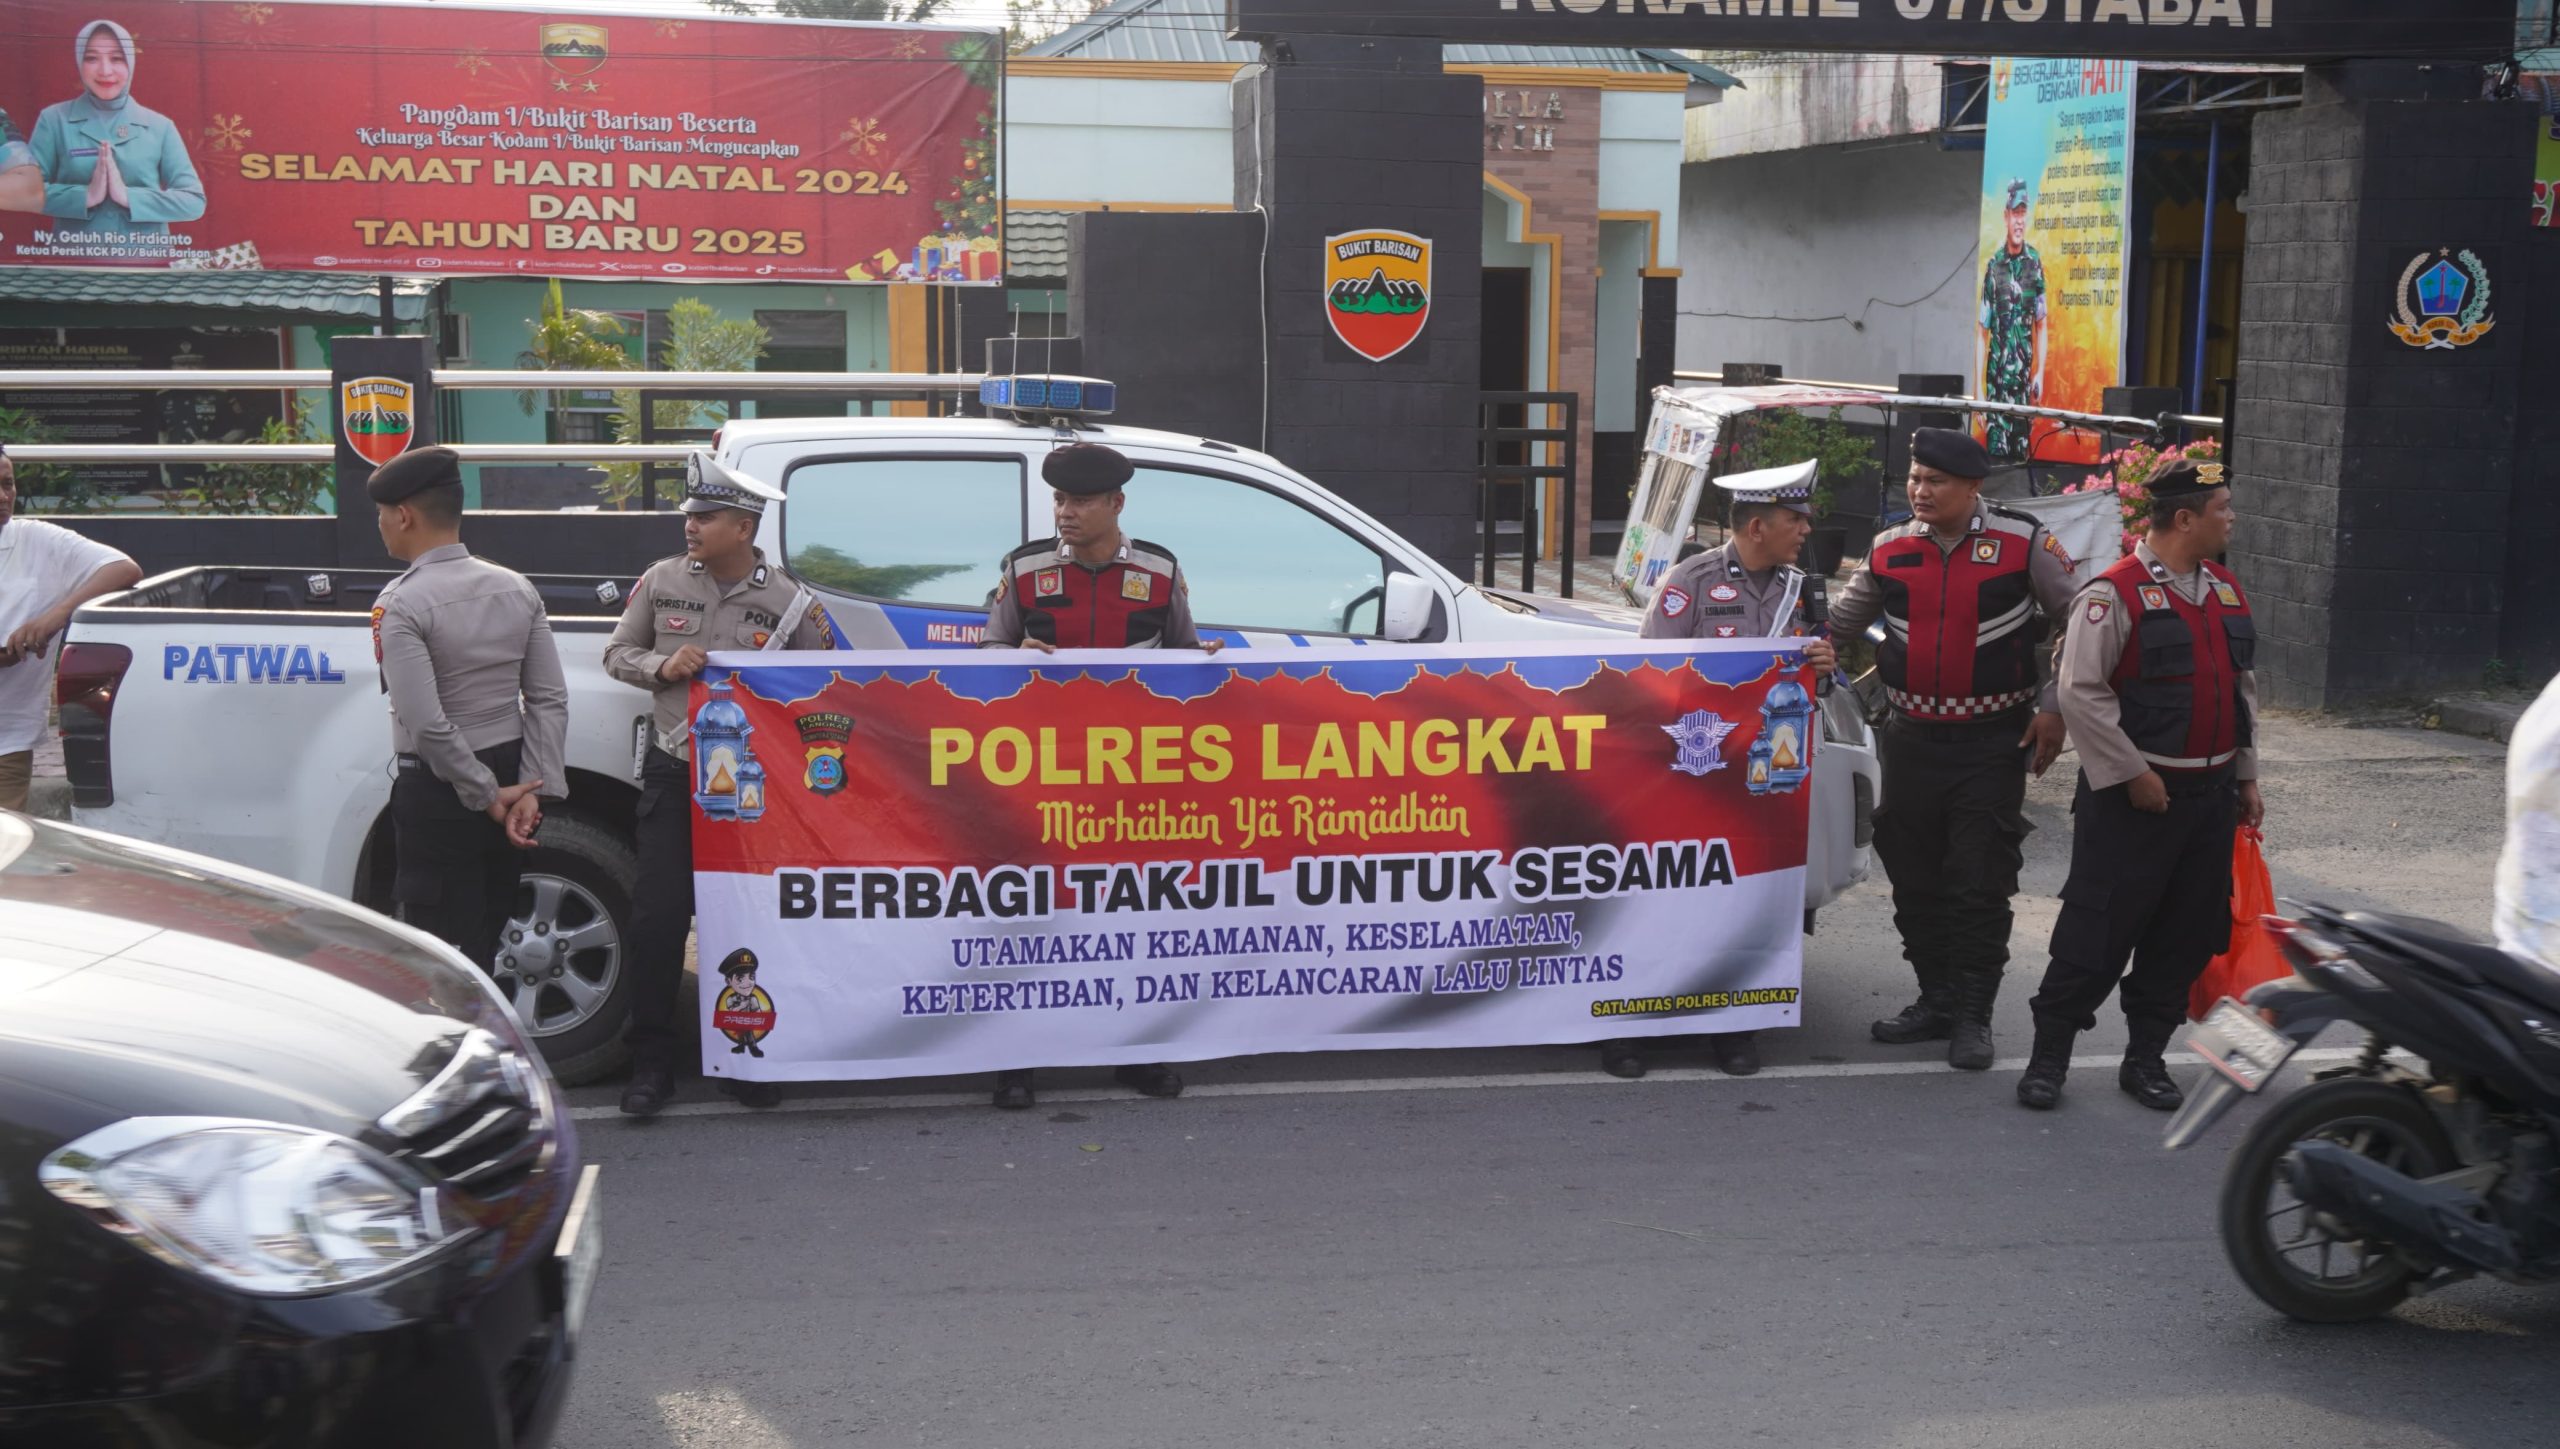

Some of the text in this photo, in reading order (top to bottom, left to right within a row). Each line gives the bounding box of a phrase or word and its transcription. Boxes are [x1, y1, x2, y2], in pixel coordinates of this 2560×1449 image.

[2014, 60, 2080, 86] BEKERJALAH
[1484, 90, 1565, 119] LLA
[2037, 79, 2080, 103] DENGAN
[400, 103, 757, 134] Pangdam I/Bukit Barisan Beserta
[355, 127, 800, 159] Keluarga Besar Kodam I/Bukit Barisan Mengucapkan
[240, 153, 909, 195] SELAMAT HARI NATAL 2024
[529, 194, 636, 222] DAN
[16, 245, 50, 256] Ketua
[52, 246, 84, 256] Persit
[86, 246, 109, 257] KCK
[111, 247, 126, 257] PD
[169, 248, 210, 259] Barisan
[34, 230, 193, 246] Ny. Galuh Rio Firdianto
[354, 220, 805, 255] TAHUN BARU 2025
[1338, 240, 1420, 261] BUKIT BARISAN
[350, 384, 405, 399] BUKIT BARISAN
[744, 610, 781, 630] POLR
[164, 643, 345, 684] PATWAL
[800, 712, 850, 726] POLRES
[931, 715, 1607, 787] POLRES LANGKAT
[1036, 792, 1471, 850] Märhäbän Yä Rämädhän
[779, 843, 1734, 919] BERBAGI TAKJIL UNTUK SESAMA
[952, 913, 1583, 968] UTAMAKAN KEAMANAN, KESELAMATAN,
[903, 953, 1624, 1015] KETERTIBAN, DAN KELANCARAN LALU LINTAS
[1592, 988, 1798, 1017] SATLANTAS POLRES LANGKAT
[723, 1015, 766, 1026] PRESISI
